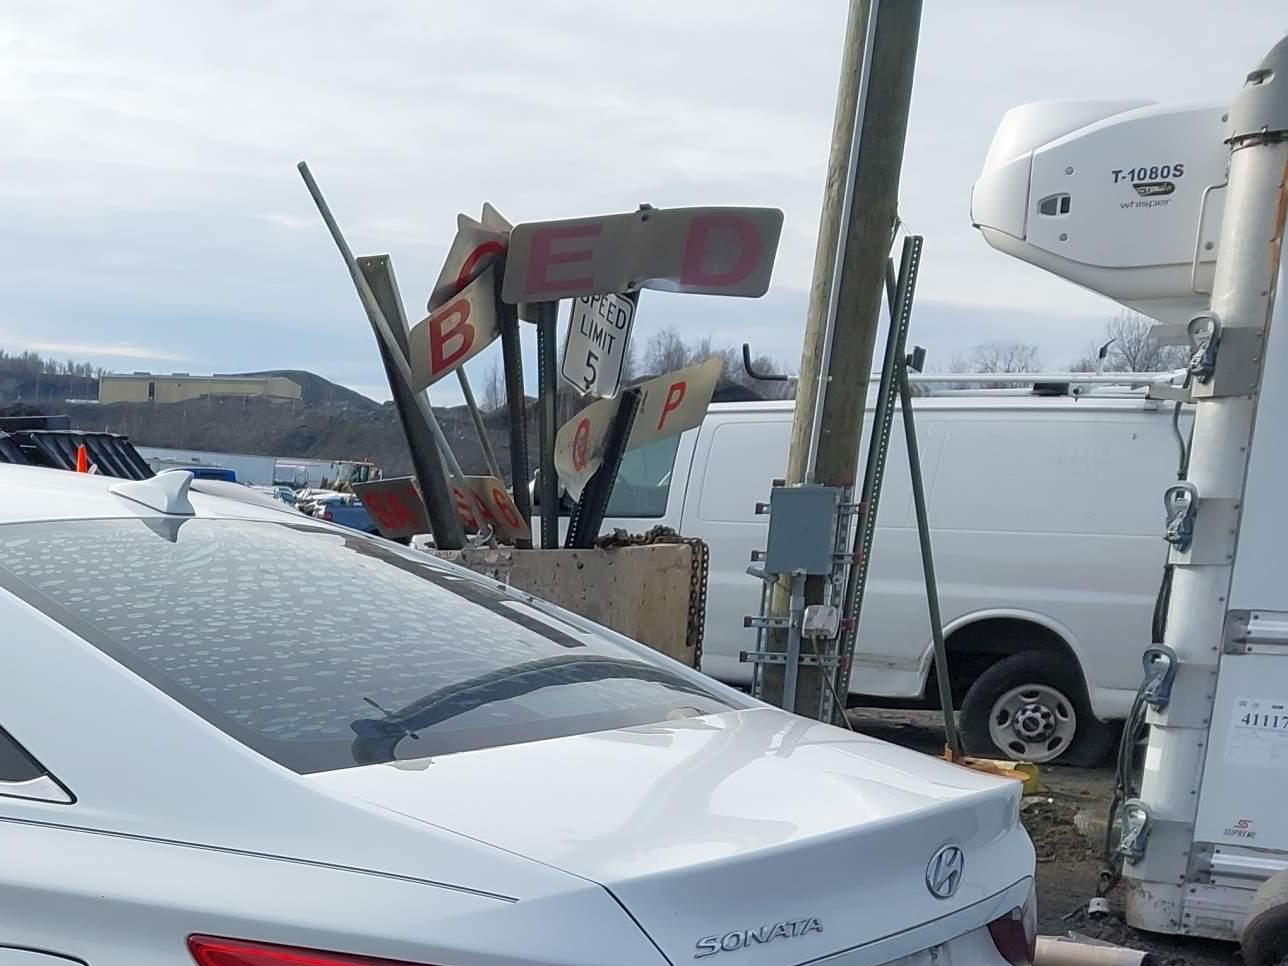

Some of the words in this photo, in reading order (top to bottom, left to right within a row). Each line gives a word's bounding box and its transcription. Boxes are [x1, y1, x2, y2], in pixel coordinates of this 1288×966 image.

[1111, 163, 1185, 184] T-1080S
[1119, 199, 1172, 209] whisper
[525, 223, 604, 295] E
[679, 211, 762, 287] D
[428, 298, 475, 376] B
[580, 313, 616, 355] LIMIT
[583, 350, 599, 386] 5
[657, 381, 687, 432] P
[694, 916, 824, 959] SONATA
